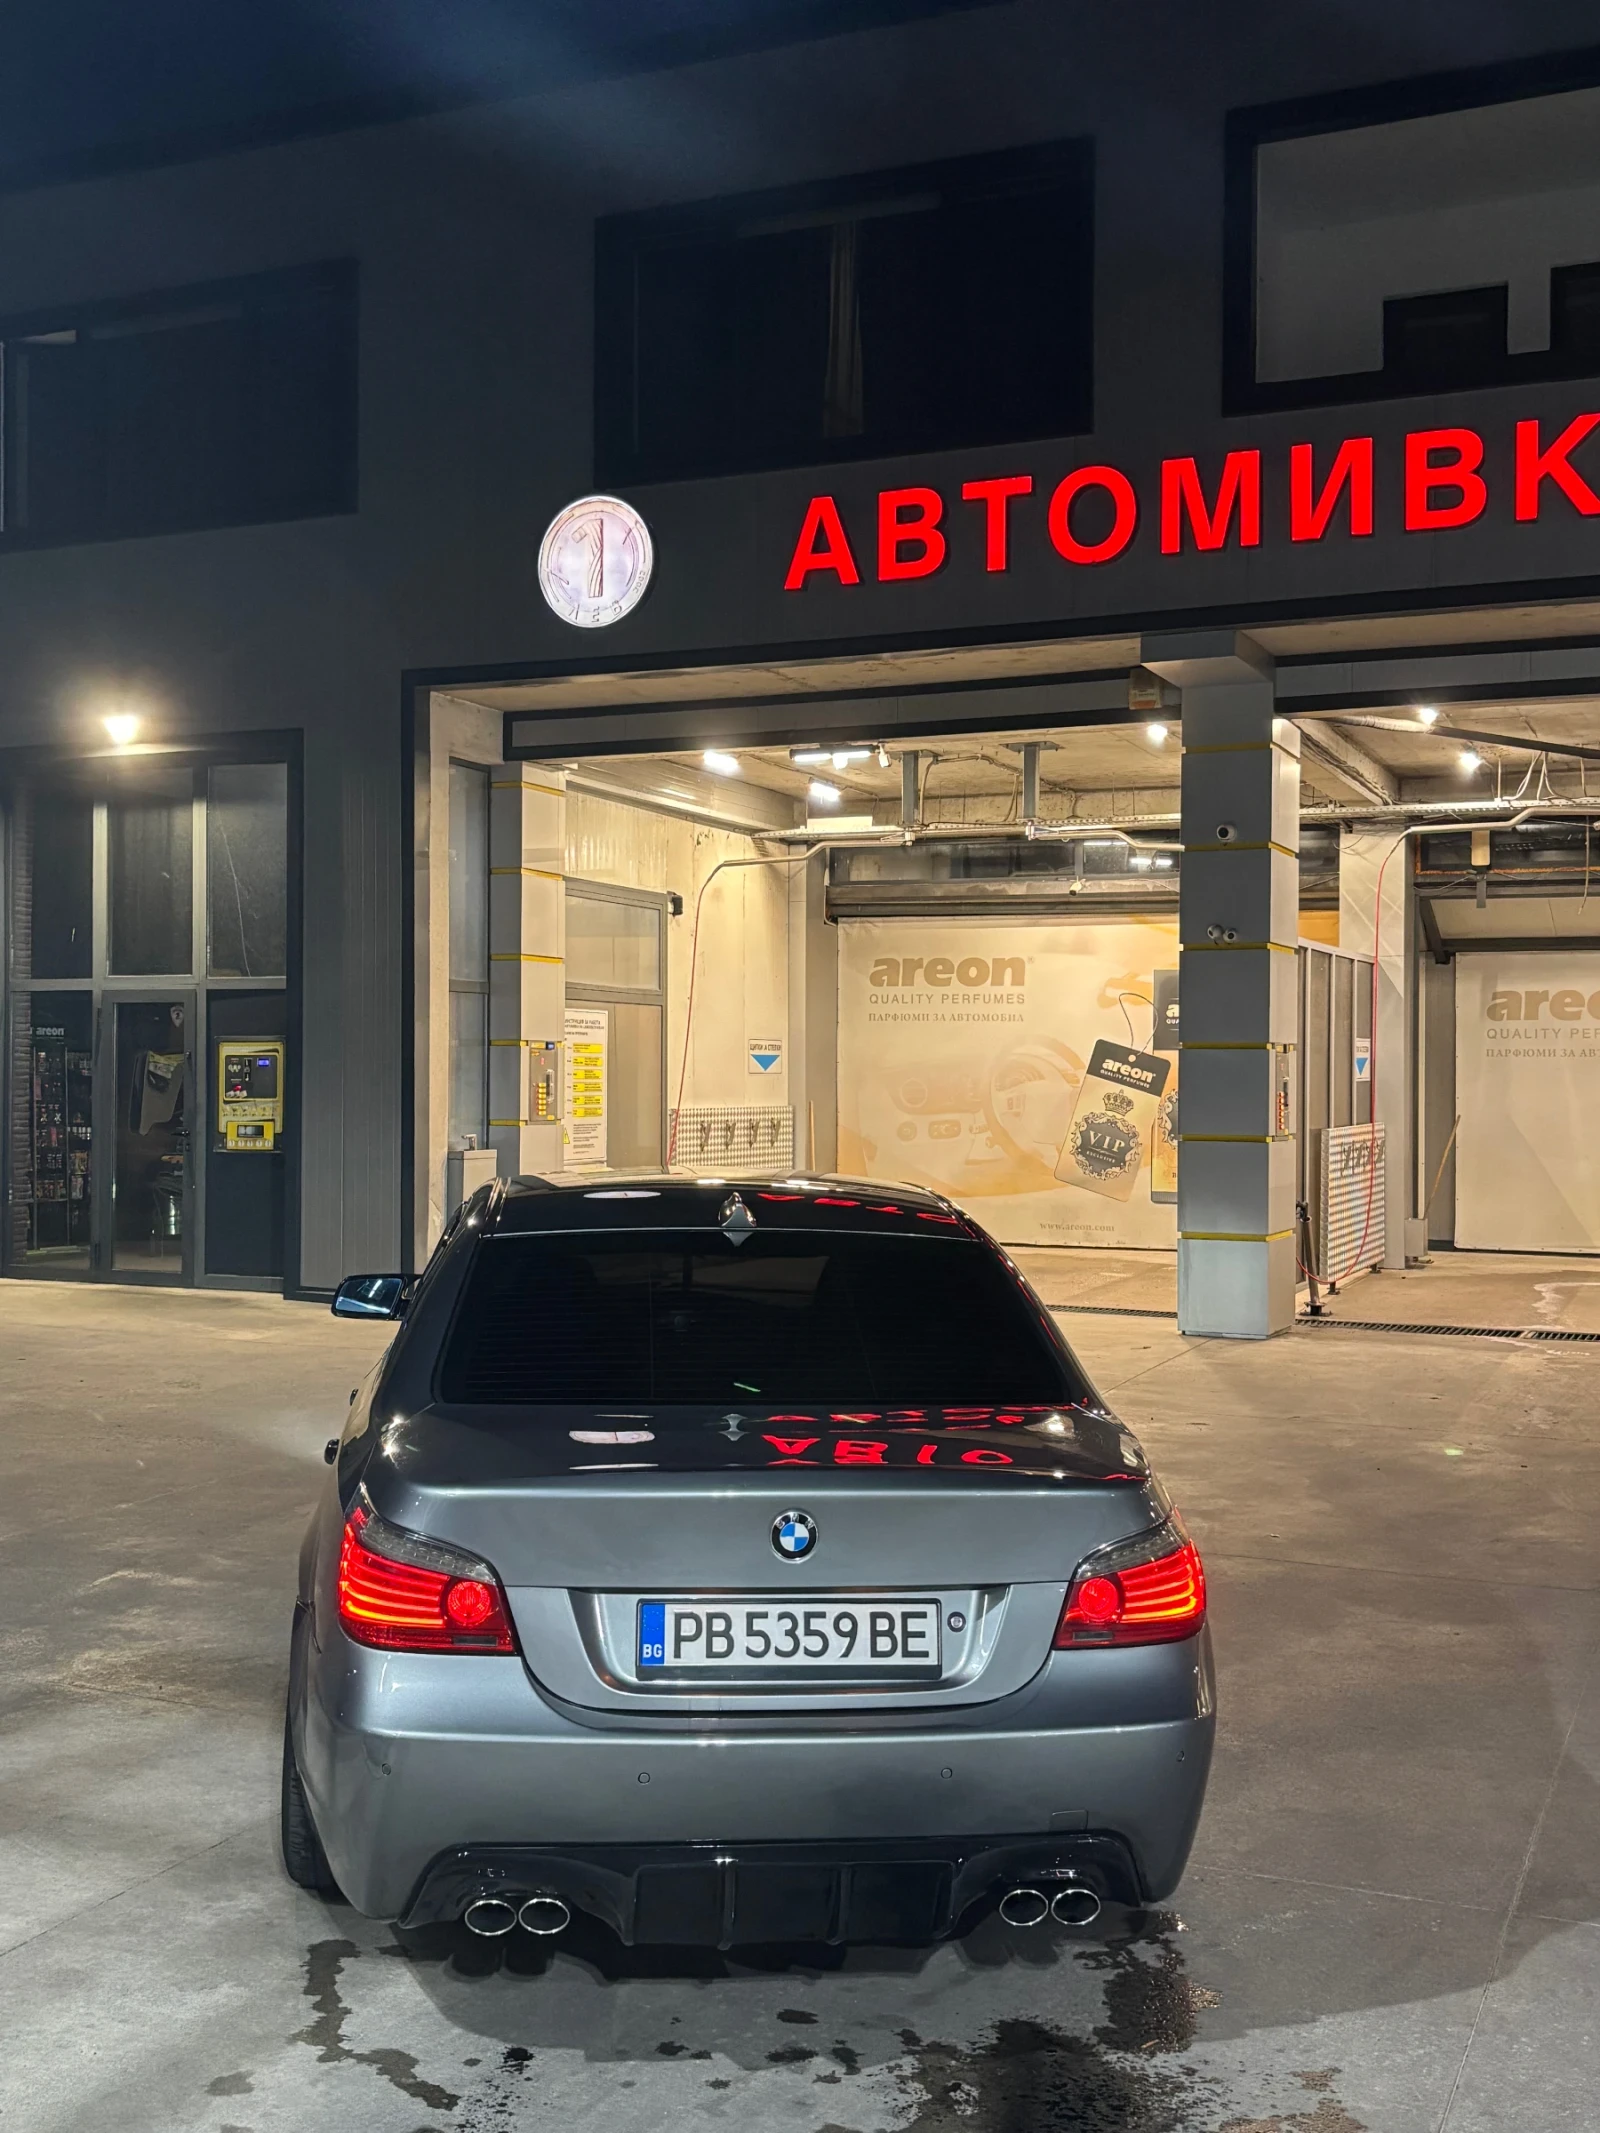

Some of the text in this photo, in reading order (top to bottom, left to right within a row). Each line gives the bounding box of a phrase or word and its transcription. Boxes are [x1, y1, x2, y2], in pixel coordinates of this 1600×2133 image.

[869, 957, 1026, 987] areon
[869, 994, 1025, 1005] QUALITY PERFUMES
[868, 1013, 929, 1022] ПАРФЮМИ
[933, 1013, 946, 1022] ЗА
[1487, 1028, 1561, 1039] QUALITY
[1486, 1048, 1556, 1057] ПАРФЮМИ
[1560, 1048, 1575, 1057] ЗА
[1102, 1059, 1153, 1083] areon
[1040, 1223, 1115, 1232] www.areon.com
[673, 1609, 930, 1658] PB 5359 BE
[642, 1643, 663, 1658] BG
